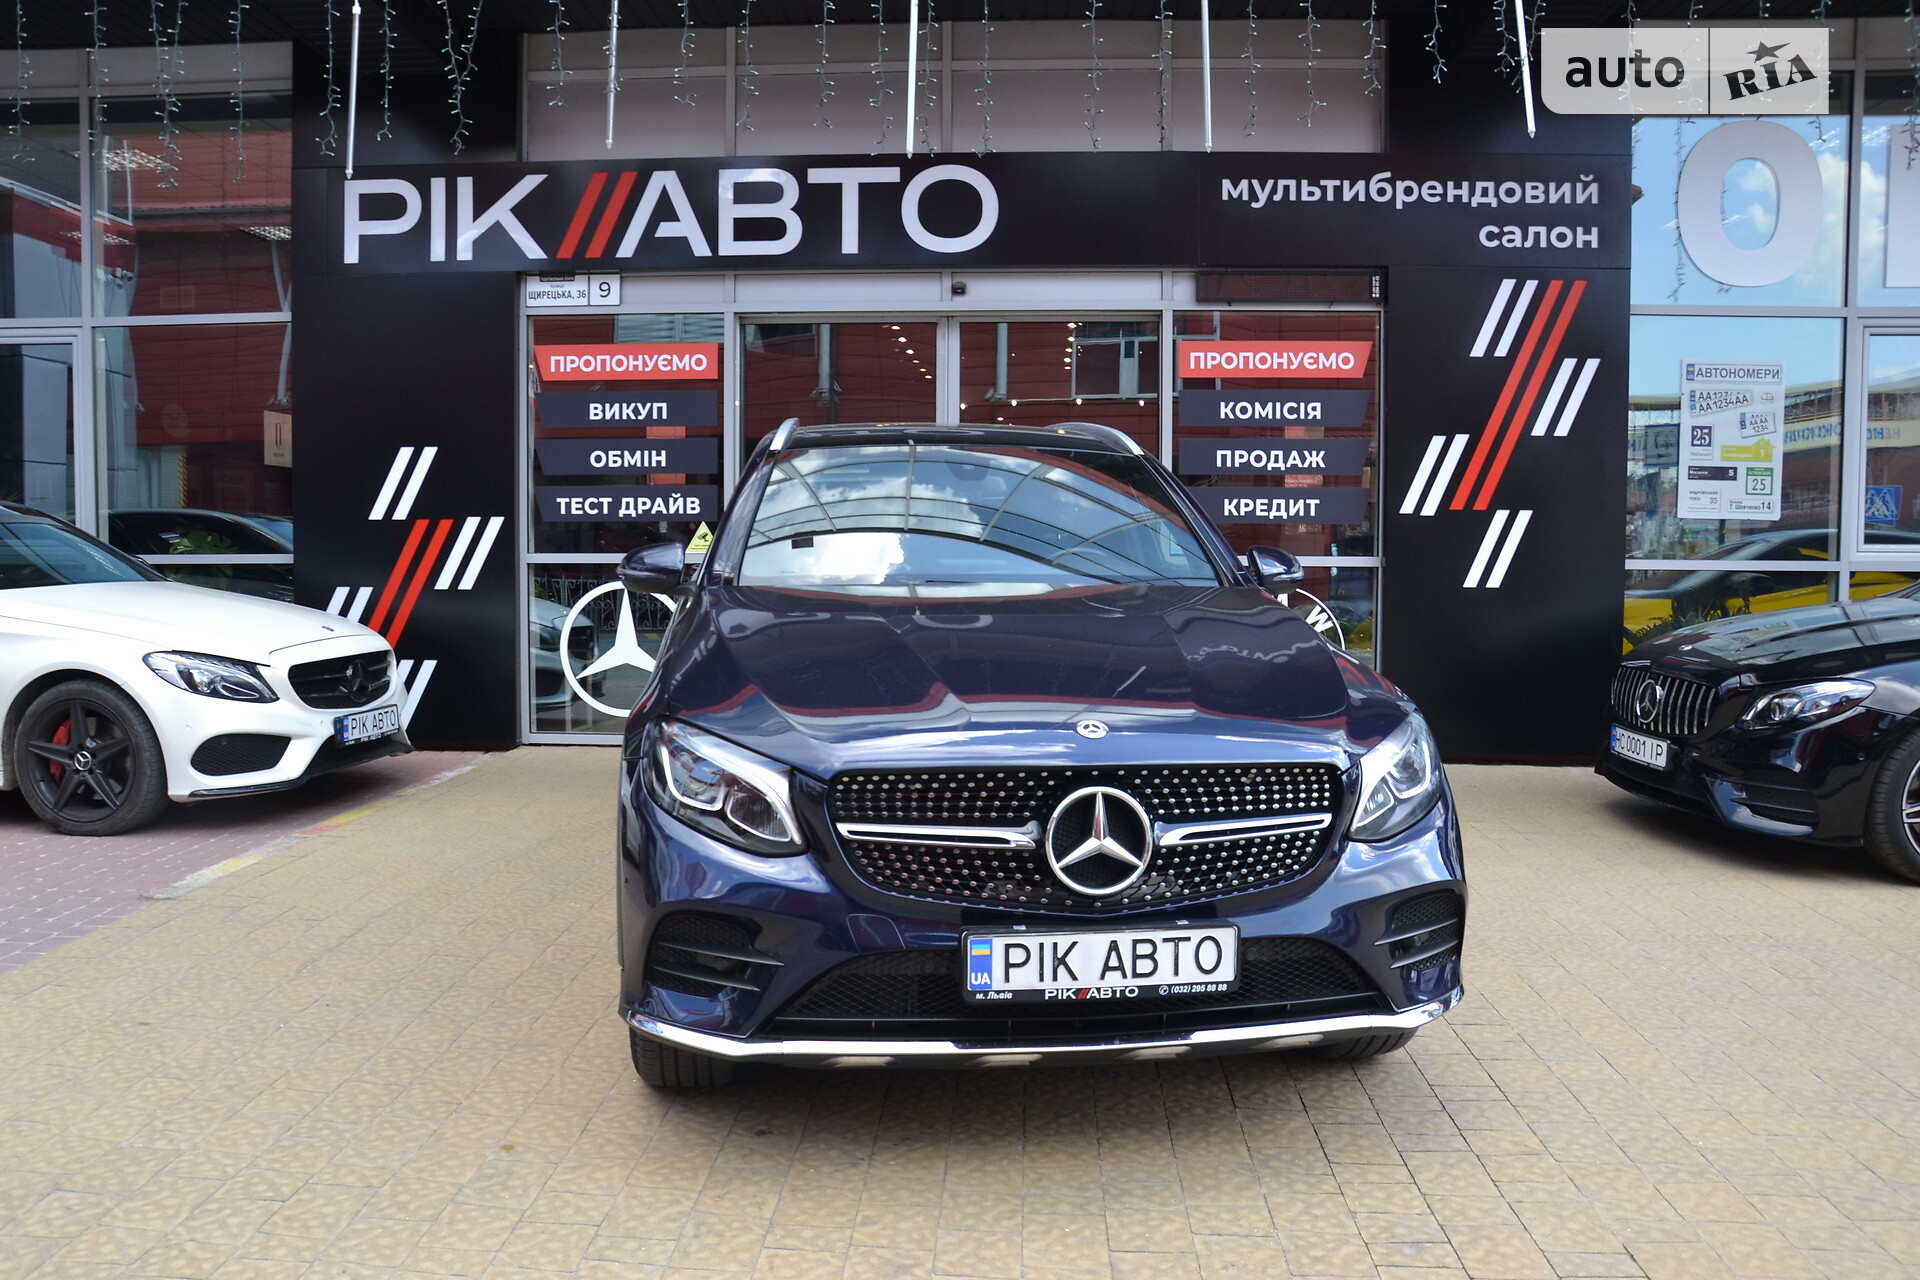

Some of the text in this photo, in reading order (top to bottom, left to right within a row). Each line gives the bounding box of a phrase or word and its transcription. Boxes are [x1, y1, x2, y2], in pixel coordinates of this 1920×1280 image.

[1221, 171, 1599, 209] мультибрендовий
[1478, 224, 1599, 249] салон
[528, 289, 586, 300] ЩИРЕЦЬКА, 36
[599, 281, 611, 298] 9
[550, 354, 707, 372] ПРОПОНУЄМО
[1189, 352, 1355, 370] ПРОПОНУЄМО
[1695, 367, 1780, 379] АВТОНОМЕРИ
[589, 402, 668, 420] ВИКУП
[1220, 401, 1322, 419] КОМІСІЯ
[1693, 428, 1709, 445] 25
[589, 450, 667, 468] ОБМІН
[1216, 450, 1326, 471] ПРОДАЖ
[1751, 478, 1766, 491] 25
[556, 493, 701, 518] ТЕСТ ДРАЙВ
[1223, 498, 1320, 519] КРЕДИТ
[1761, 501, 1771, 510] 14
[1003, 935, 1223, 983] РІК АВТО
[971, 972, 991, 985] UA
[1170, 984, 1191, 993] (032)
[1191, 984, 1206, 992] 295
